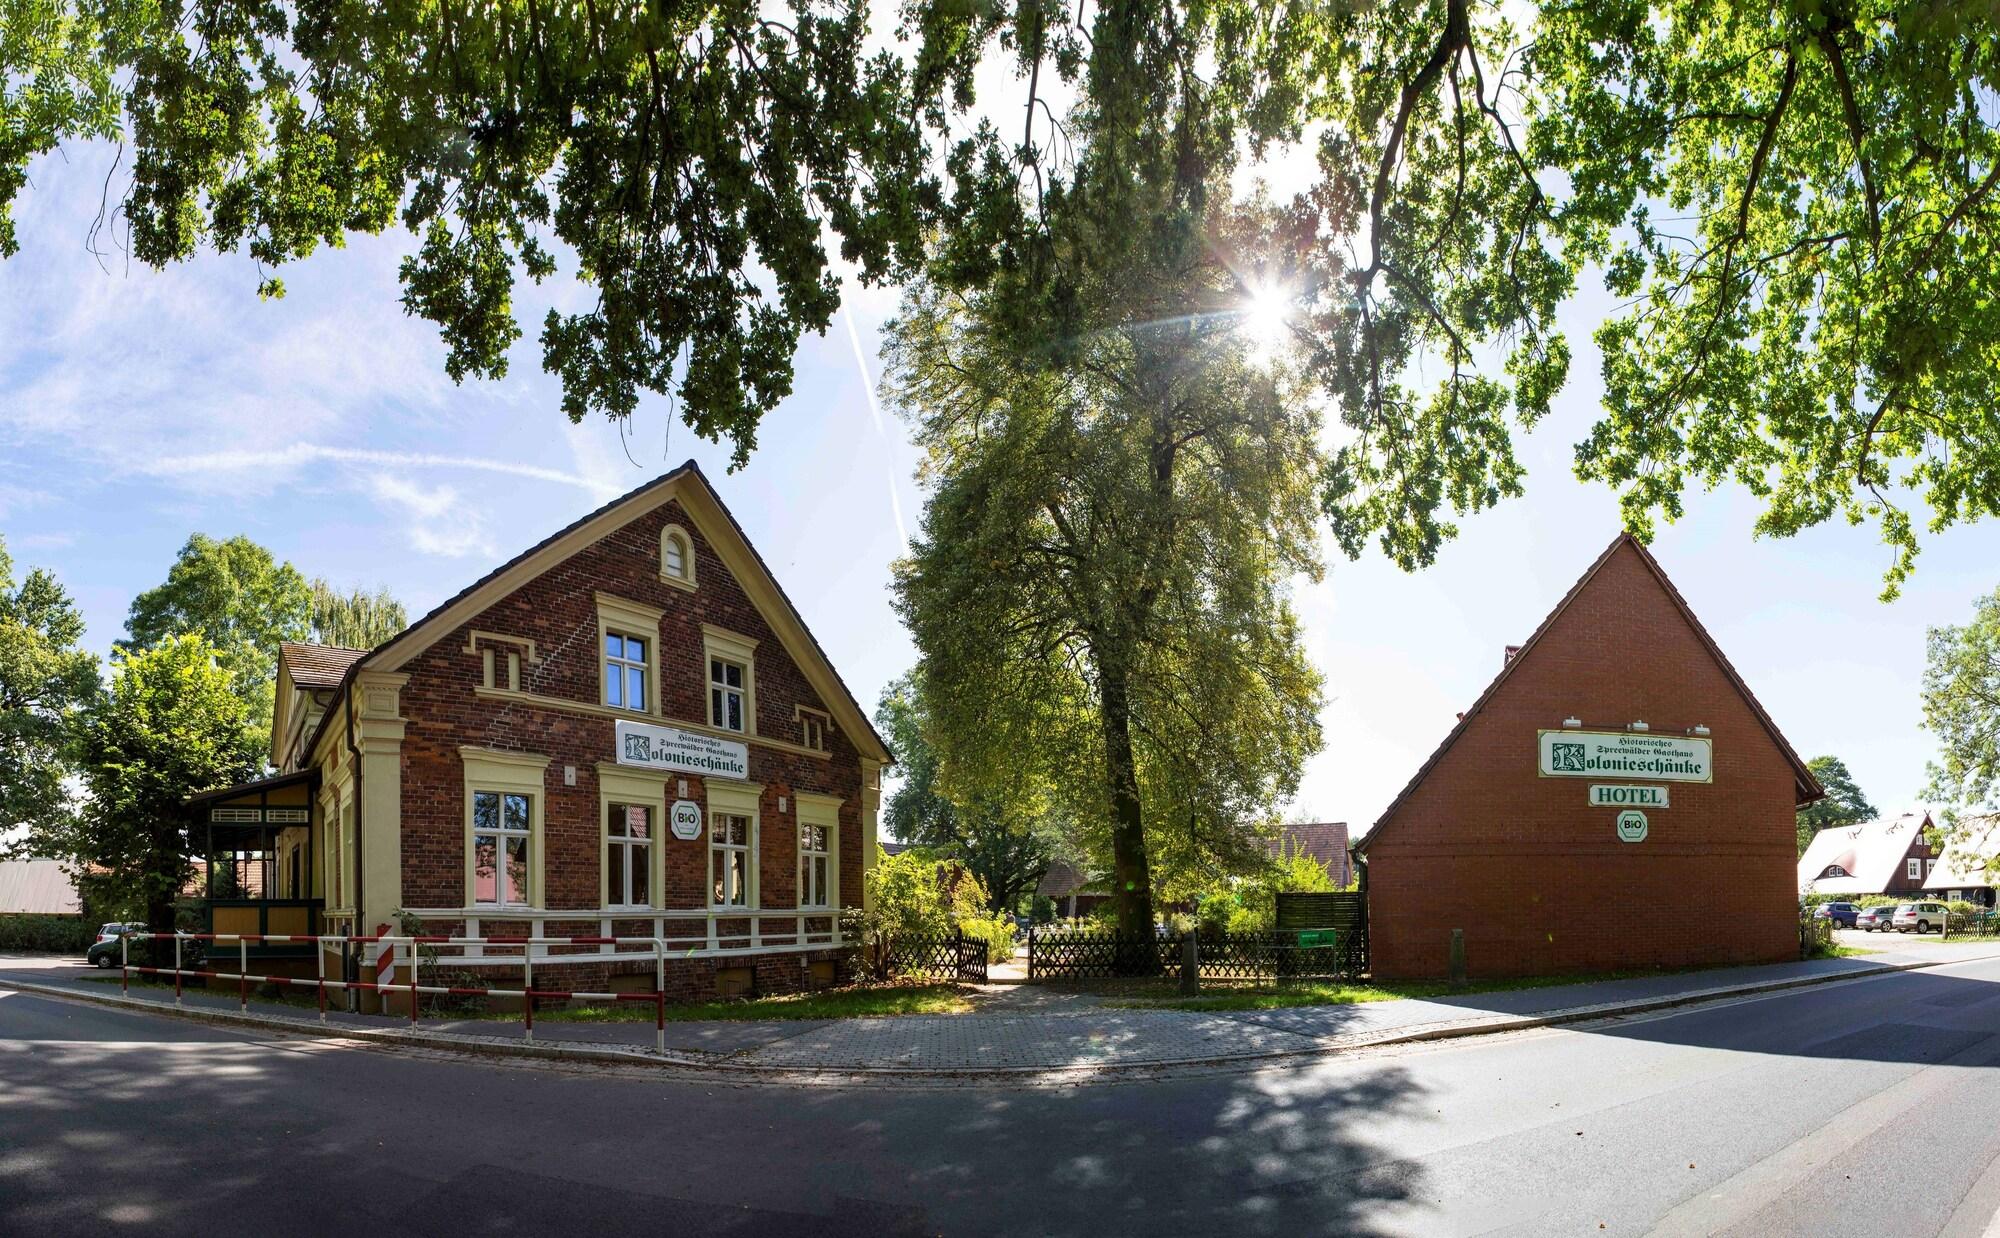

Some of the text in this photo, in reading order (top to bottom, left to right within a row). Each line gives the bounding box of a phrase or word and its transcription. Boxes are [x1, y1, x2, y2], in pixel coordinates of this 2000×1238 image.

[660, 738, 738, 759] Spreewälder Gasthaus
[678, 733, 721, 748] Historisches
[1618, 737, 1673, 748] Historisches
[624, 733, 744, 774] Kolonieschänke
[1552, 743, 1702, 775] Kolonieschänke
[1596, 745, 1694, 758] Spreewälder Gasthaus
[1598, 787, 1662, 804] HOTEL
